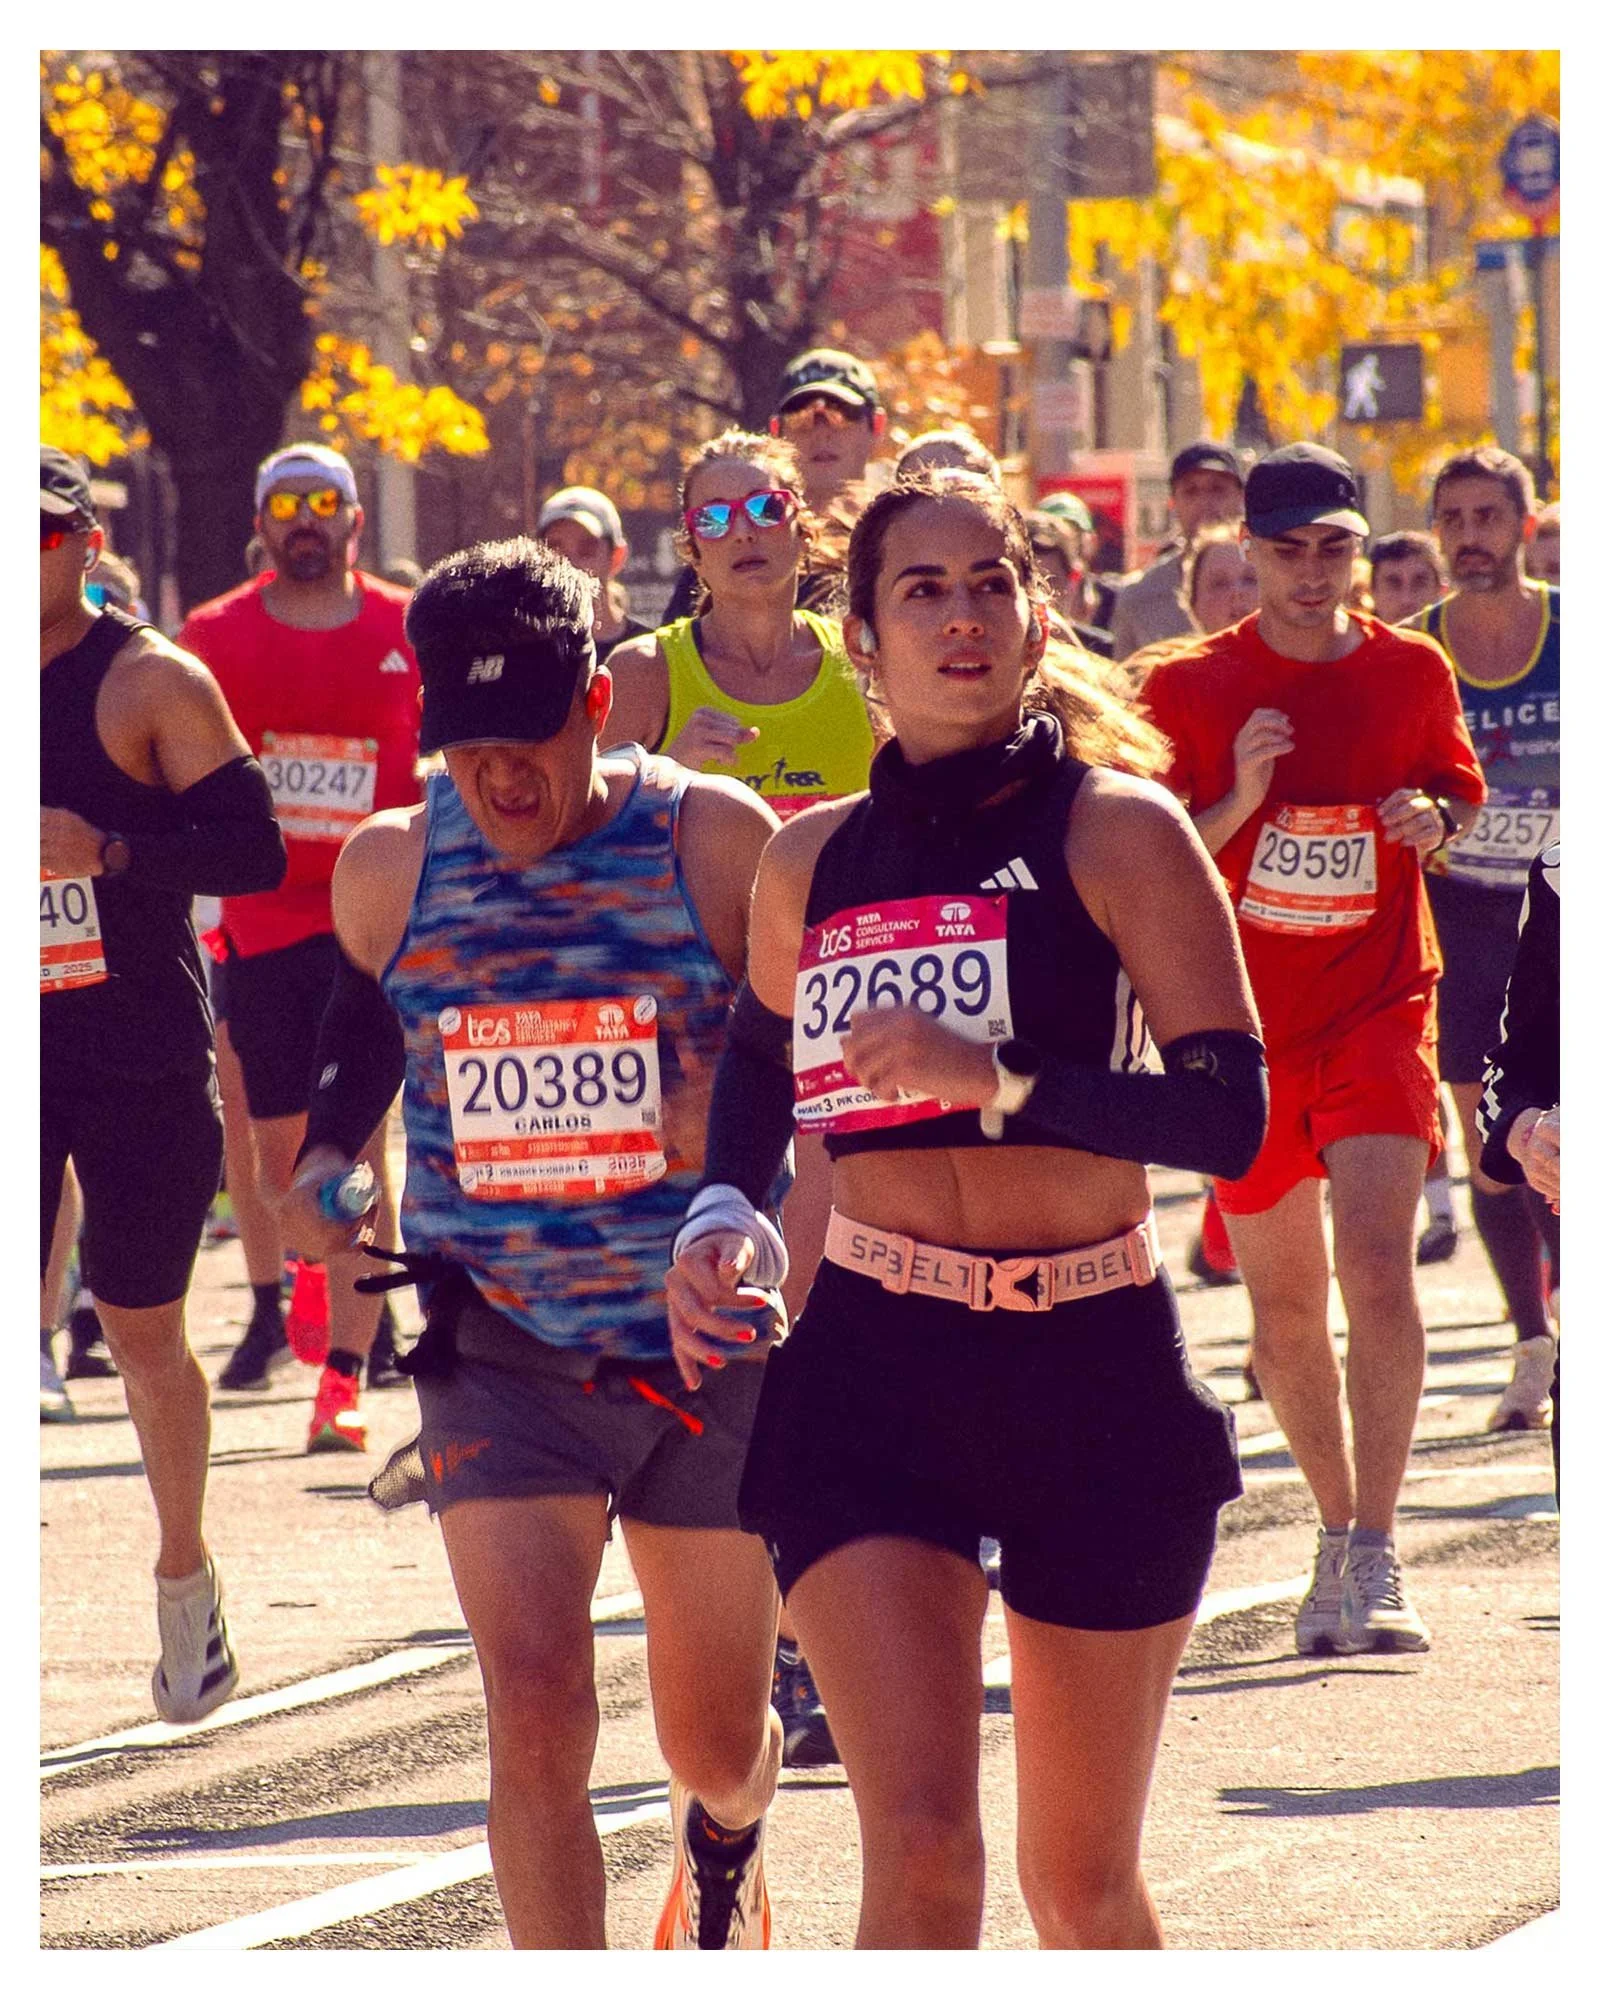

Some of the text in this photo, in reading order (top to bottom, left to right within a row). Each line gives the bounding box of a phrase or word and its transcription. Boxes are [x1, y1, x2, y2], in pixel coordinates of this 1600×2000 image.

[266, 760, 366, 798] 30247
[1462, 812, 1552, 846] 3257
[1258, 831, 1365, 879] 29597
[40, 883, 88, 928] 40
[856, 911, 882, 927] TATA
[856, 919, 921, 935] CONSULTANCY
[935, 923, 977, 939] TATA
[856, 932, 896, 950] SERVICES
[803, 950, 993, 1040] 32689
[468, 1013, 512, 1047] tcs
[595, 1024, 629, 1041] TATA
[458, 1049, 647, 1115] 20389
[823, 1098, 834, 1113] 3
[514, 1113, 592, 1133] CARLOS
